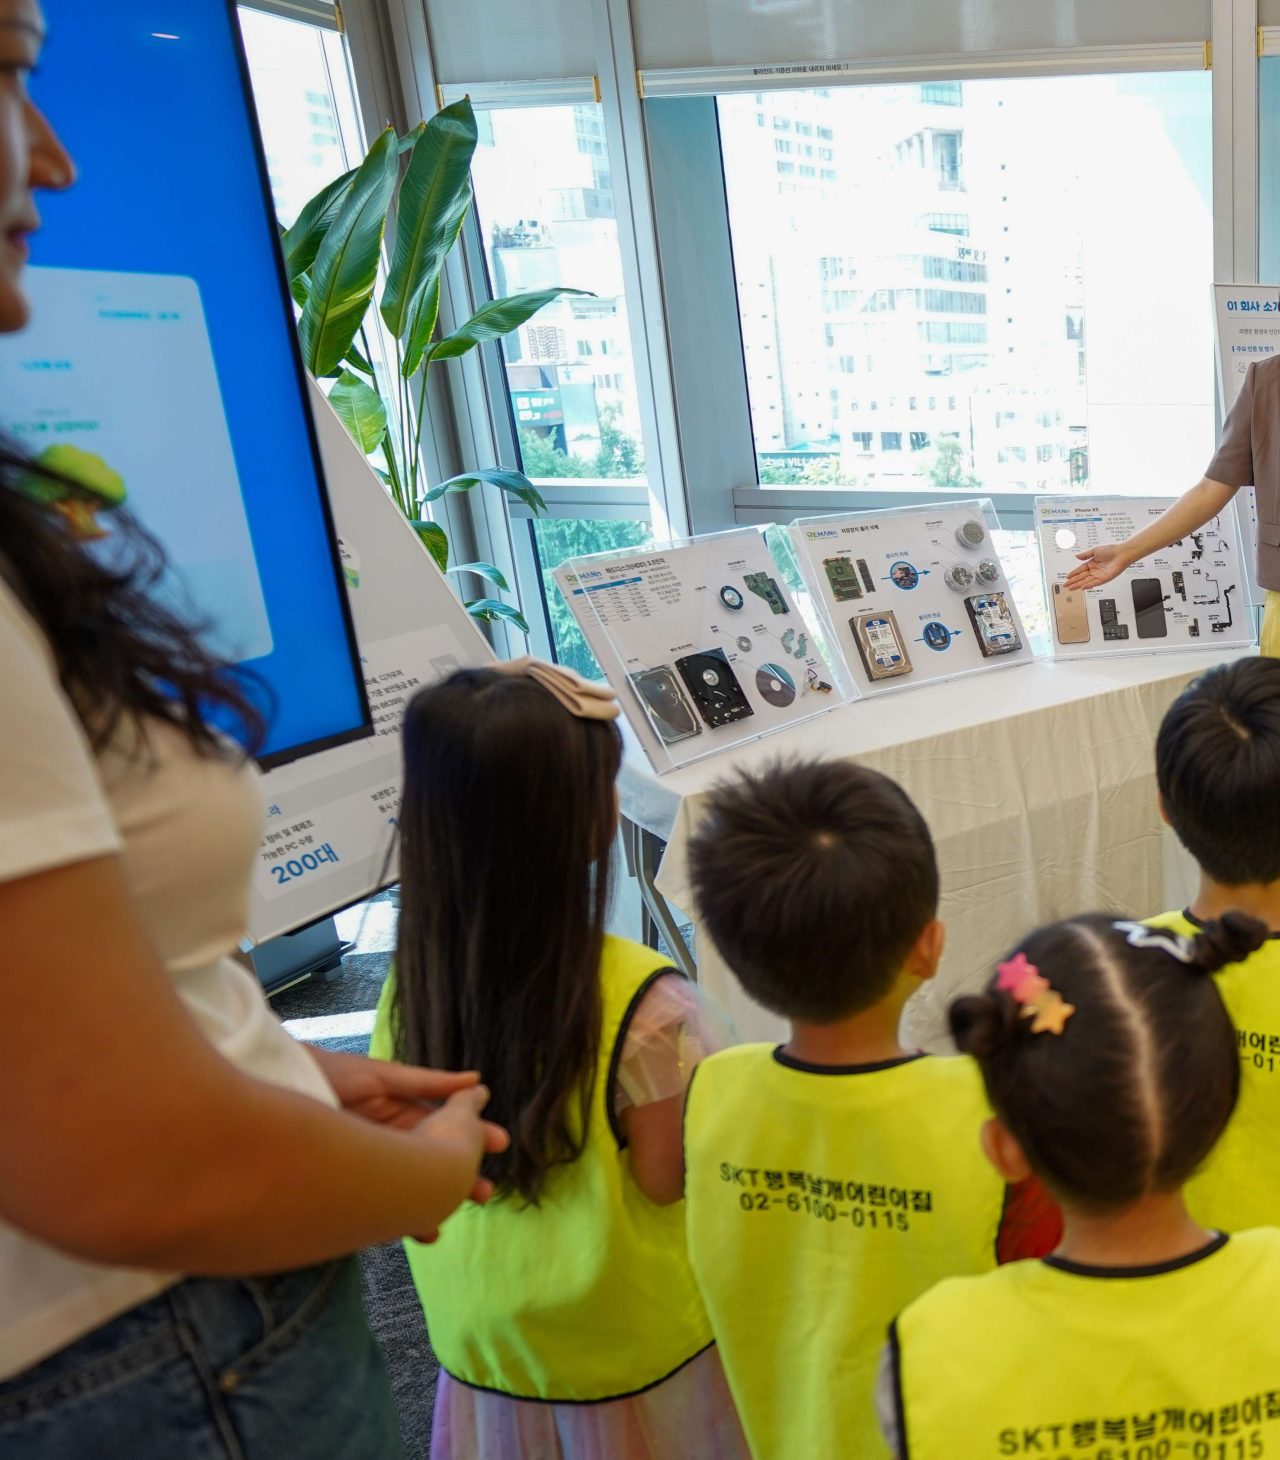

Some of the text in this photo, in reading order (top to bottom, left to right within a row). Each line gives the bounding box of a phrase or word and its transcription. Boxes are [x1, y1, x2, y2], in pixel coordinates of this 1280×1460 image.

[1240, 300, 1260, 312] 회사
[262, 847, 286, 860] 가능한
[285, 842, 298, 851] PC
[271, 843, 339, 884] 200대
[740, 1192, 910, 1232] 02-6100-0115
[1037, 1430, 1265, 1460] -6100-0115
